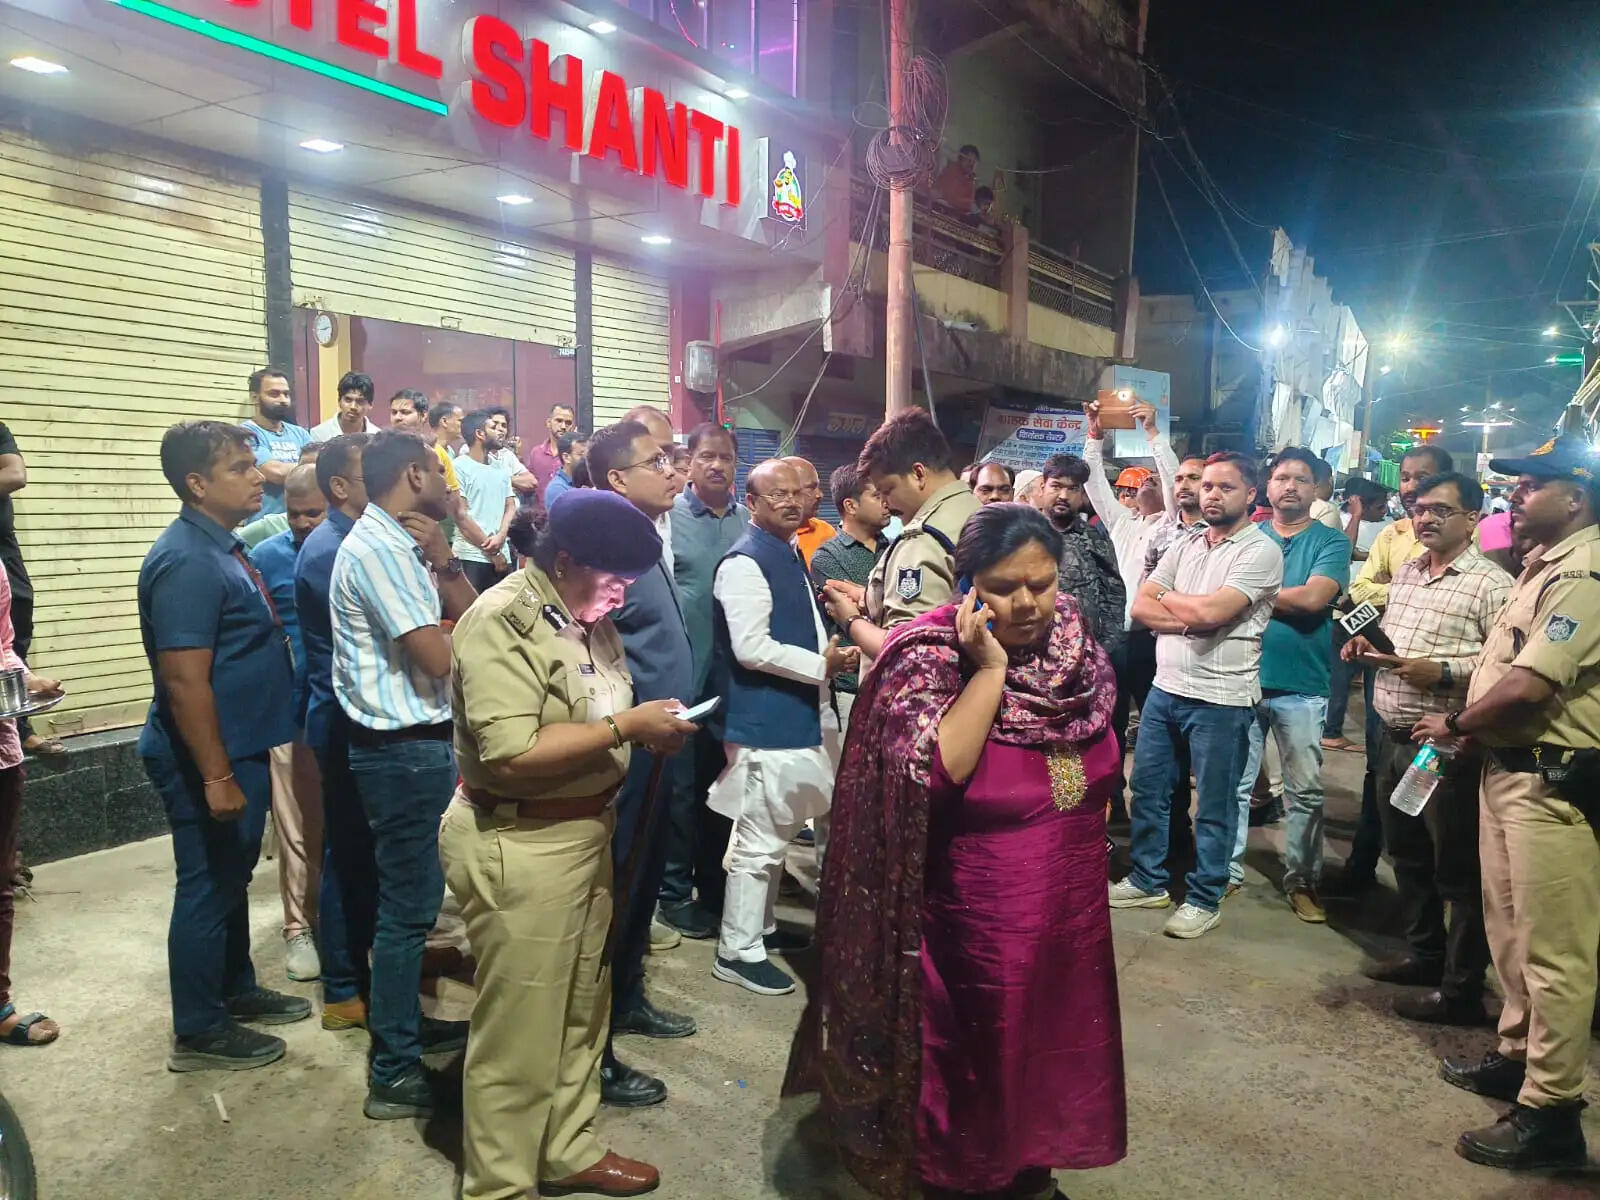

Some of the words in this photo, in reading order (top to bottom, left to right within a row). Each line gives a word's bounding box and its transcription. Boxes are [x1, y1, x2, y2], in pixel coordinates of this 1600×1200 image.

[470, 14, 741, 208] SHANTI
[1033, 416, 1053, 429] सेवा
[1350, 606, 1373, 629] ANI
